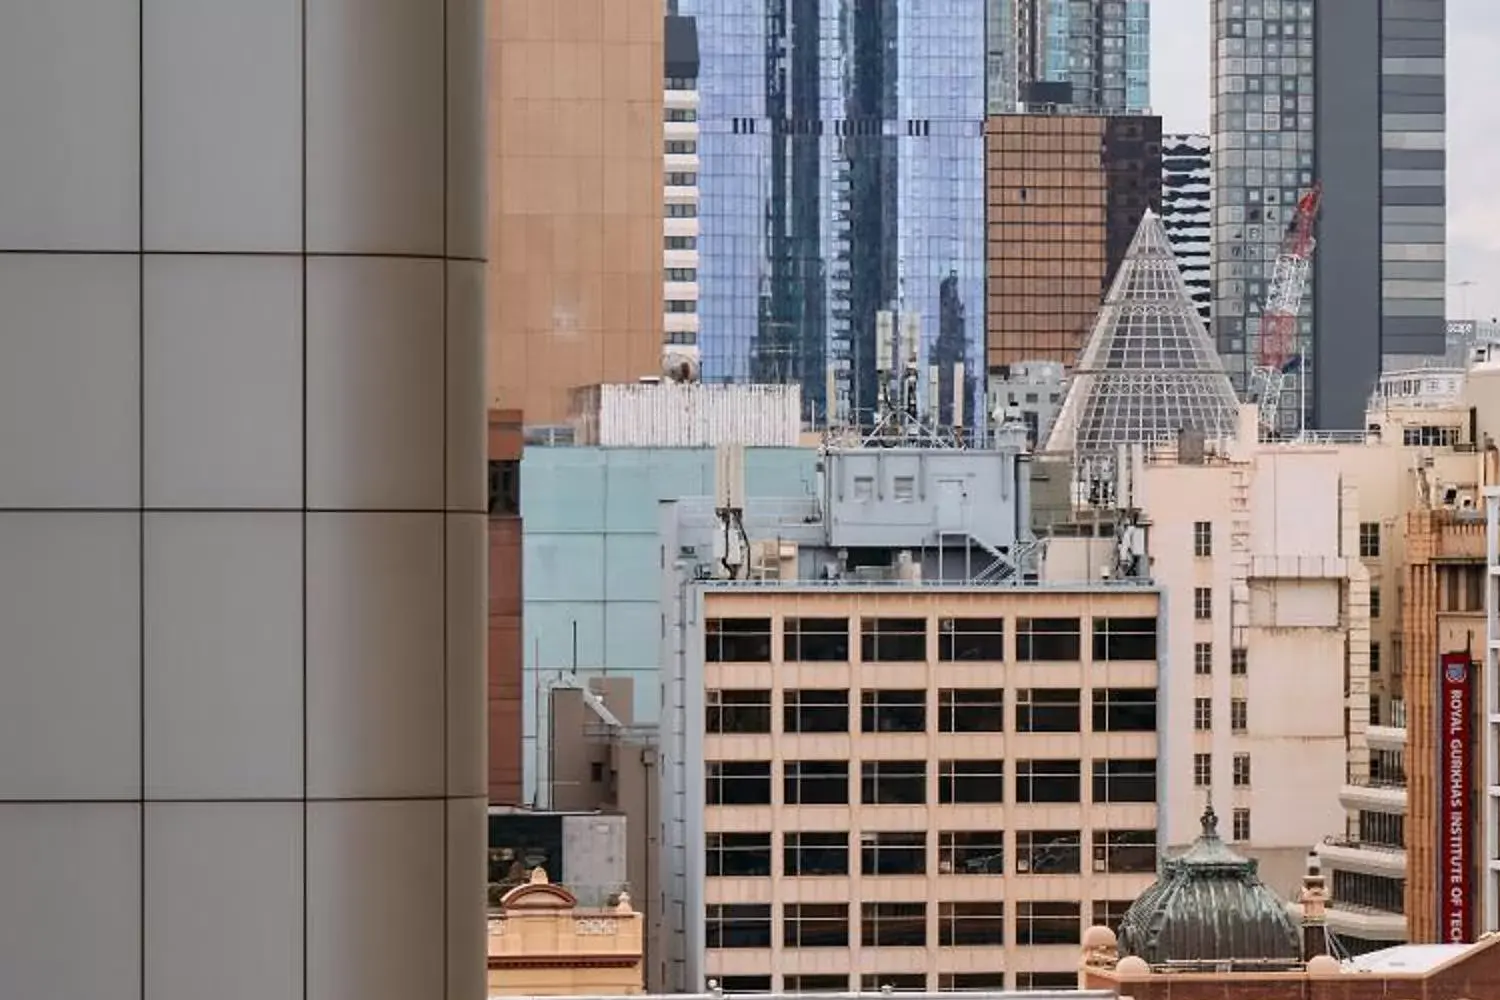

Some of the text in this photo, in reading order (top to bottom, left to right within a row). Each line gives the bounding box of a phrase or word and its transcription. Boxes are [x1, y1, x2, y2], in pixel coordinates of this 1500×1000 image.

[1450, 689, 1463, 735] ROYAL
[1450, 739, 1463, 808] GURKHAS
[1450, 811, 1463, 884] INSTITUTE
[1450, 887, 1463, 907] OF
